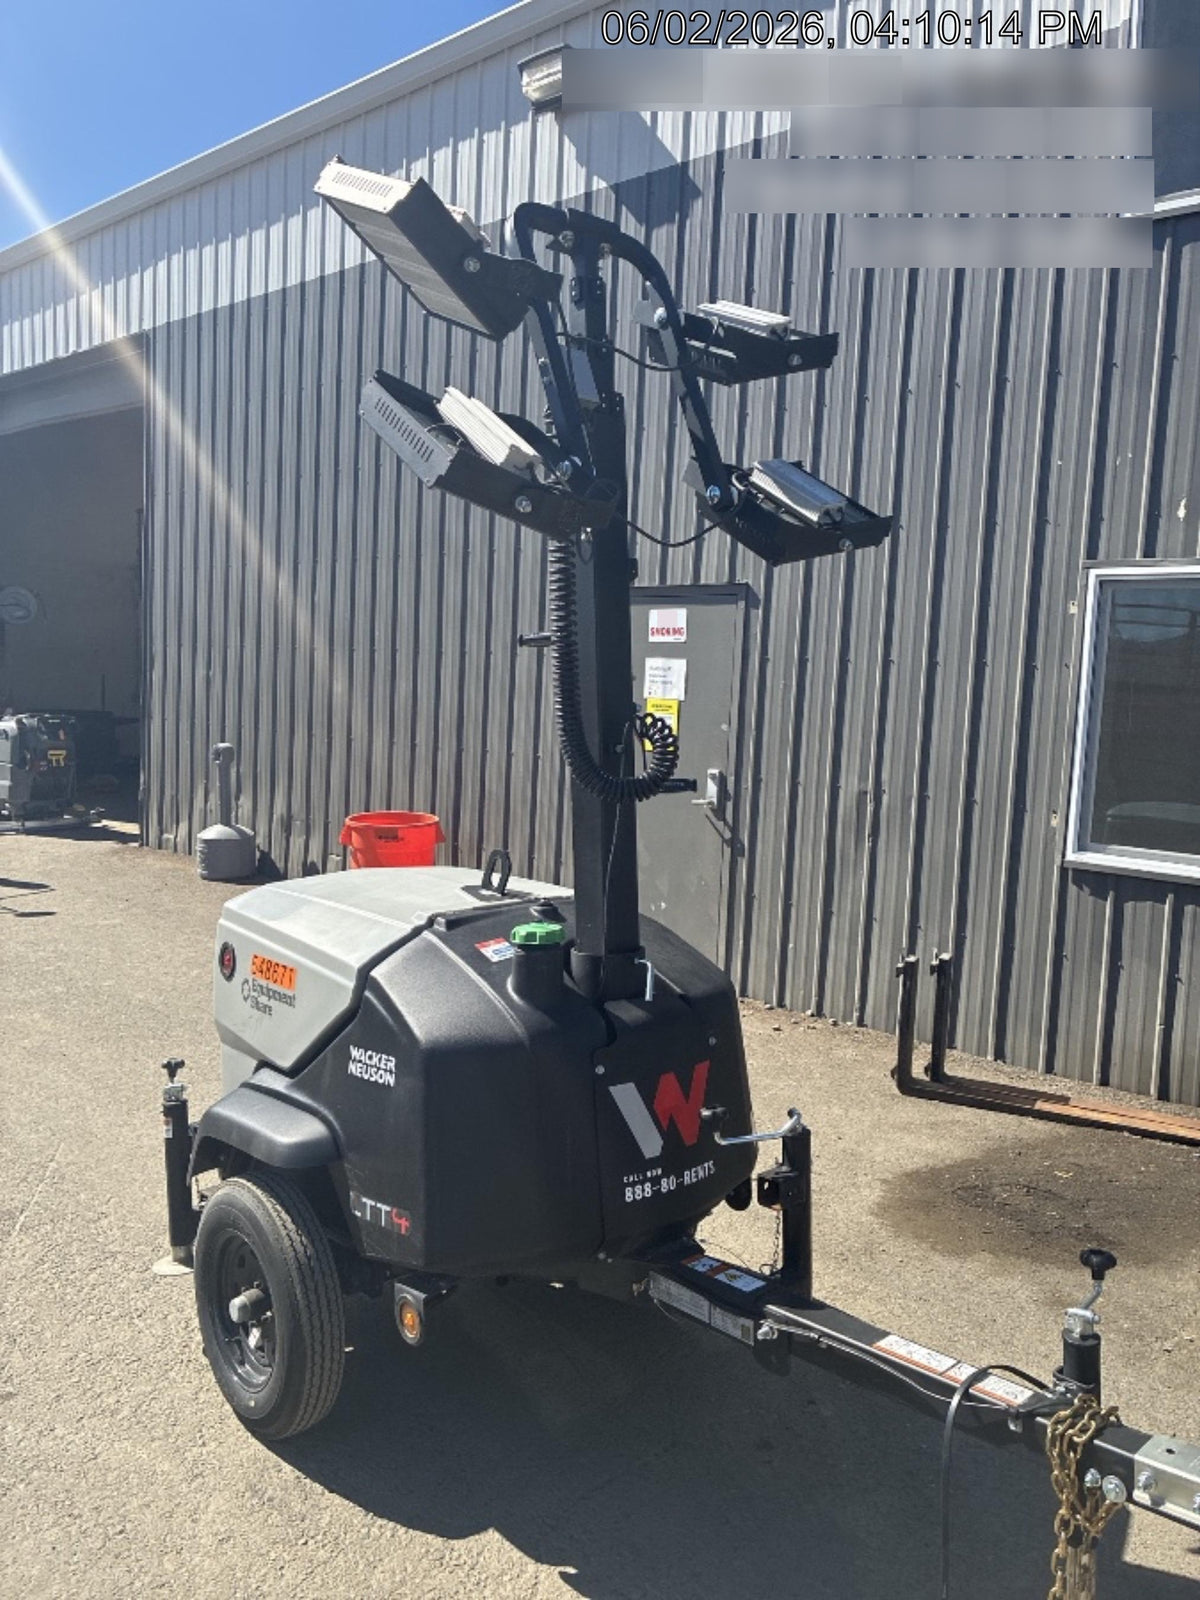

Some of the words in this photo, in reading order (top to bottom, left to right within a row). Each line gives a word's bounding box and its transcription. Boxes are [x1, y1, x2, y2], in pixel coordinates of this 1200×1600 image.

[250, 995, 273, 1016] Share
[252, 978, 296, 1008] Equipment
[349, 1044, 396, 1073] WACKER
[347, 1060, 396, 1088] NEUSON
[624, 1160, 716, 1203] 888-80-RENTS
